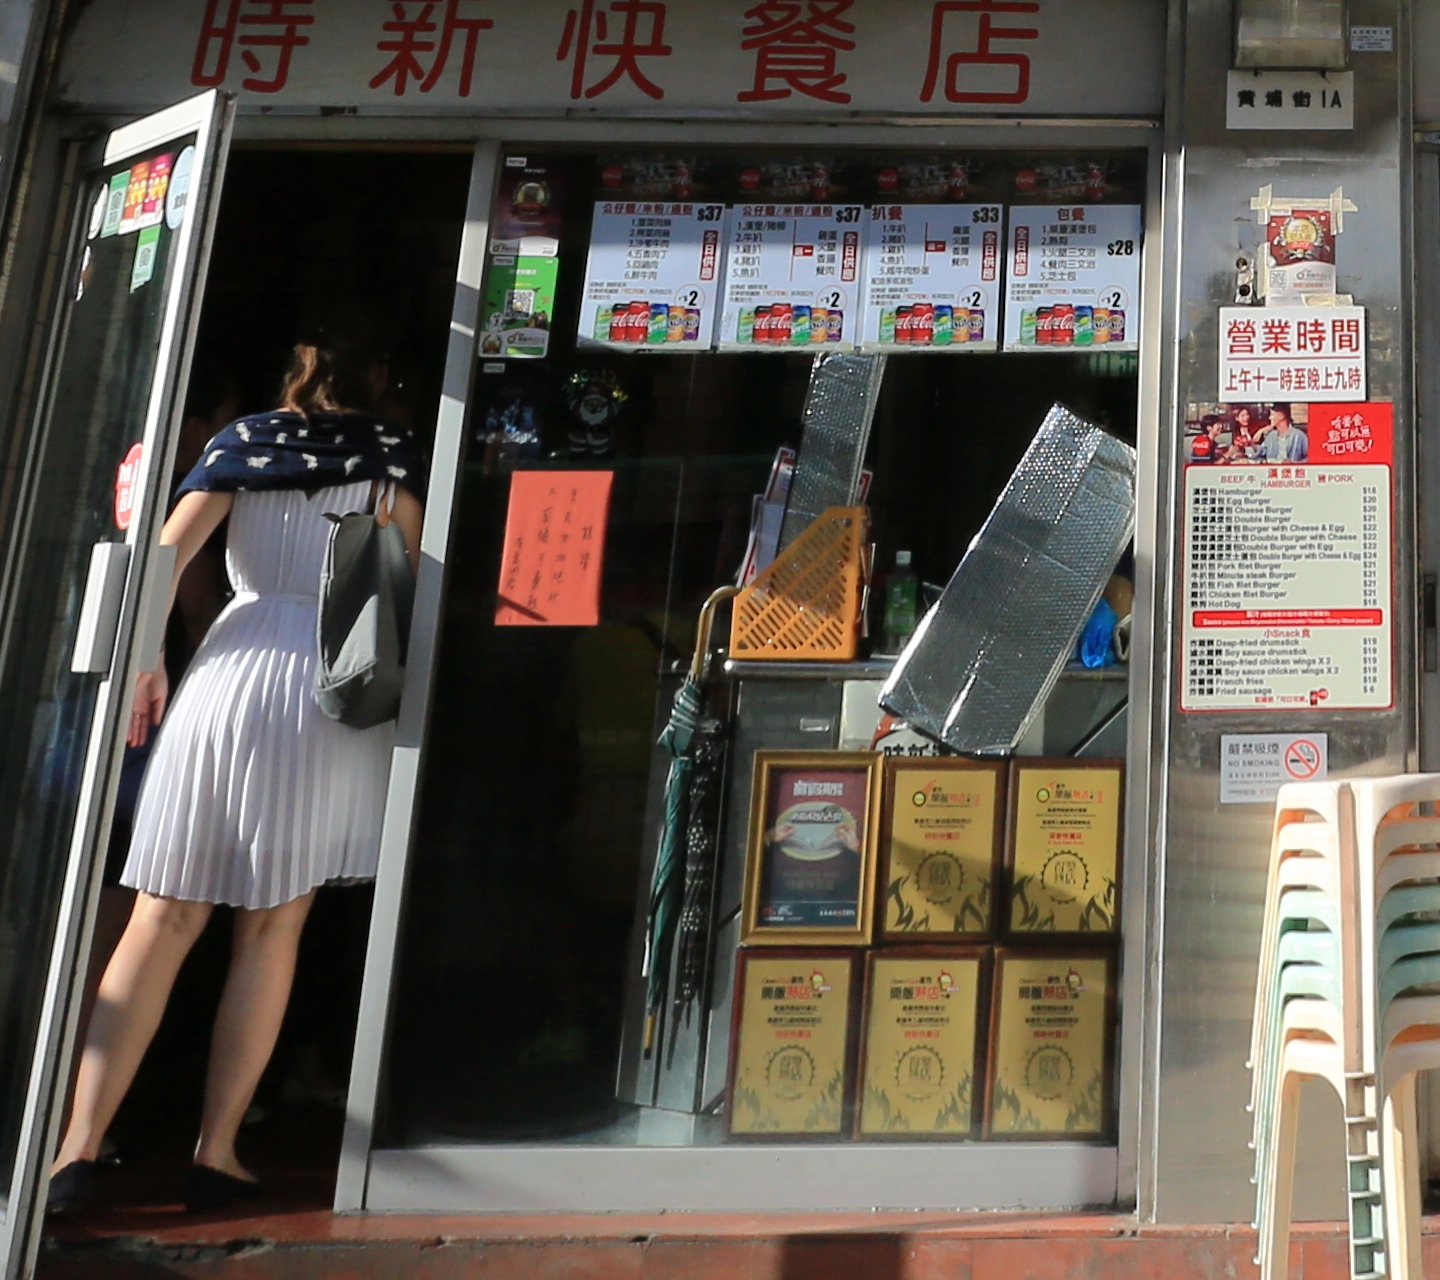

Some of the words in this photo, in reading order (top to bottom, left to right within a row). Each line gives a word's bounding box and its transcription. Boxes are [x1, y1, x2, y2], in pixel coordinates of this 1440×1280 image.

[698, 206, 722, 222] $37
[836, 207, 860, 223] $37
[972, 208, 999, 223] $33
[1057, 208, 1085, 220] 包餐
[1108, 240, 1134, 256] $28
[1227, 318, 1360, 354] 營業時間
[1225, 365, 1362, 392] 上午十一時至晚上九時
[1248, 475, 1257, 484] 牛
[1261, 480, 1311, 488] HAMBURGER
[1328, 475, 1354, 483] PORK
[1219, 488, 1263, 496] Hamburger
[1226, 497, 1242, 506] Egg
[1244, 497, 1272, 505] Burger
[1265, 506, 1293, 515] Burger
[1264, 516, 1292, 524] Burger
